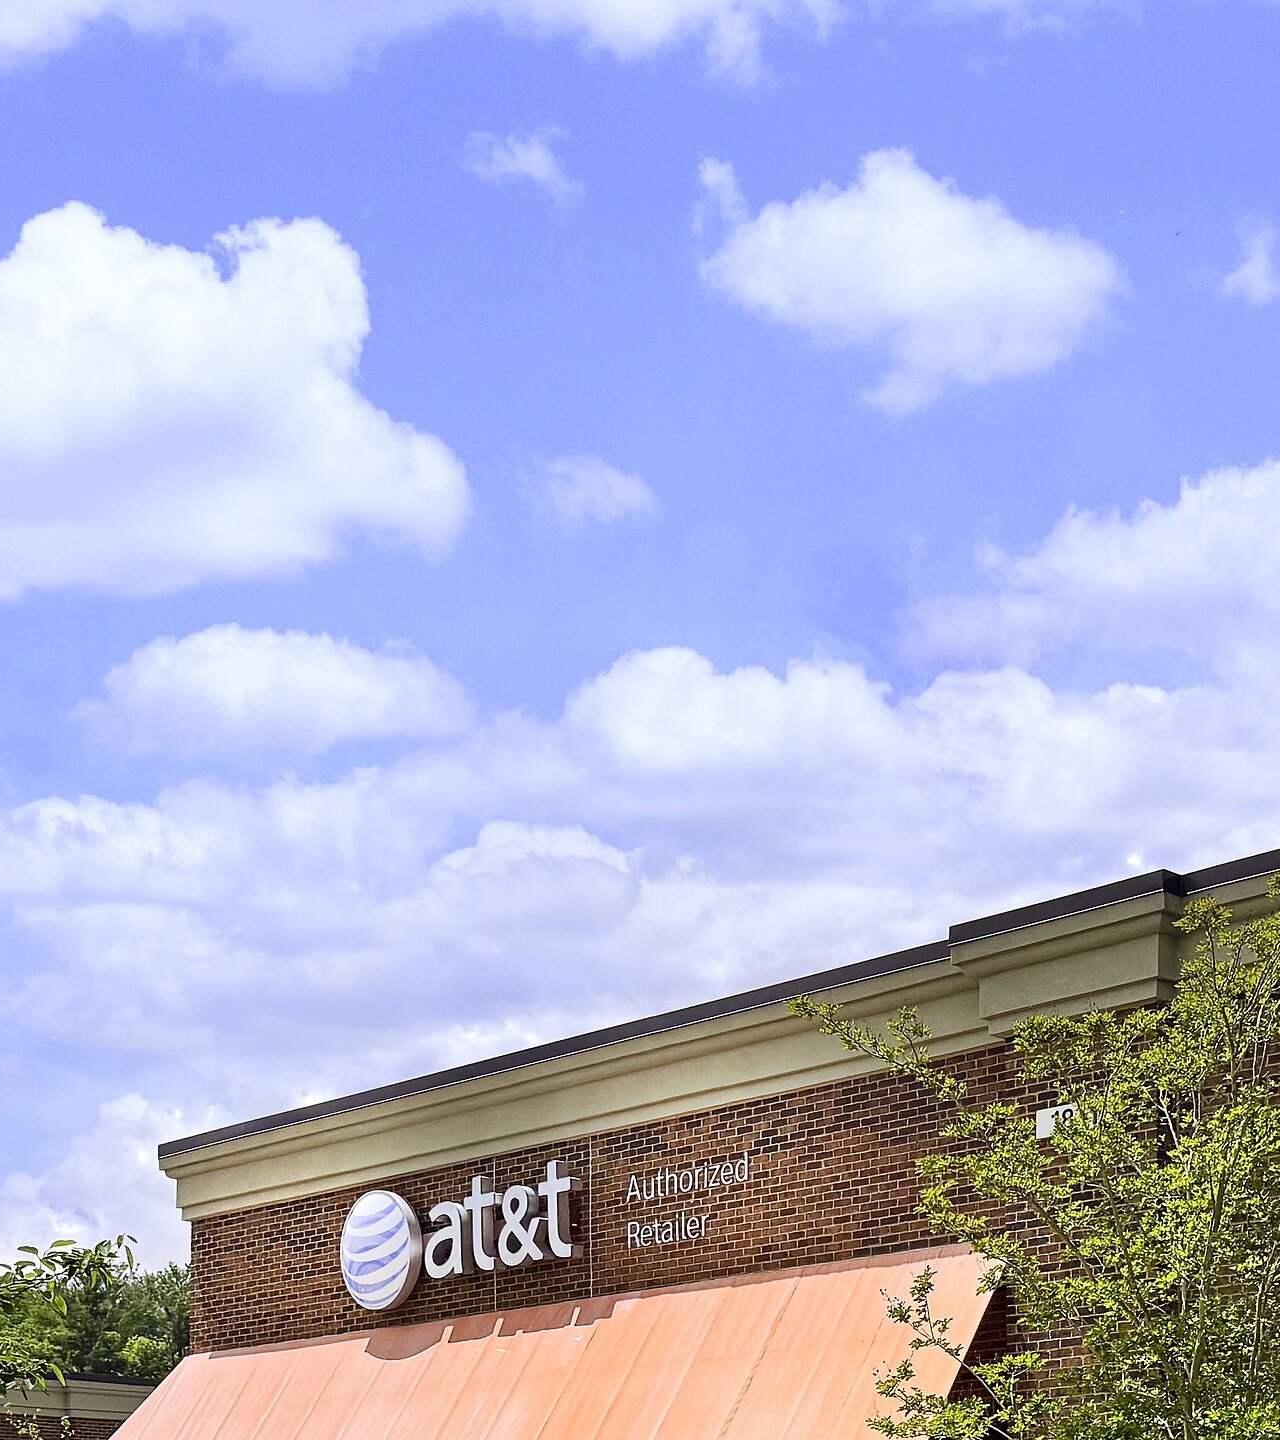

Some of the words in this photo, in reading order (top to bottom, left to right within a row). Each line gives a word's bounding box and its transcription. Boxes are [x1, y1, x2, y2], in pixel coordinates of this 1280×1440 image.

[626, 1151, 749, 1203] Authorized
[424, 1160, 573, 1280] at&t
[626, 1211, 710, 1249] Retailer
